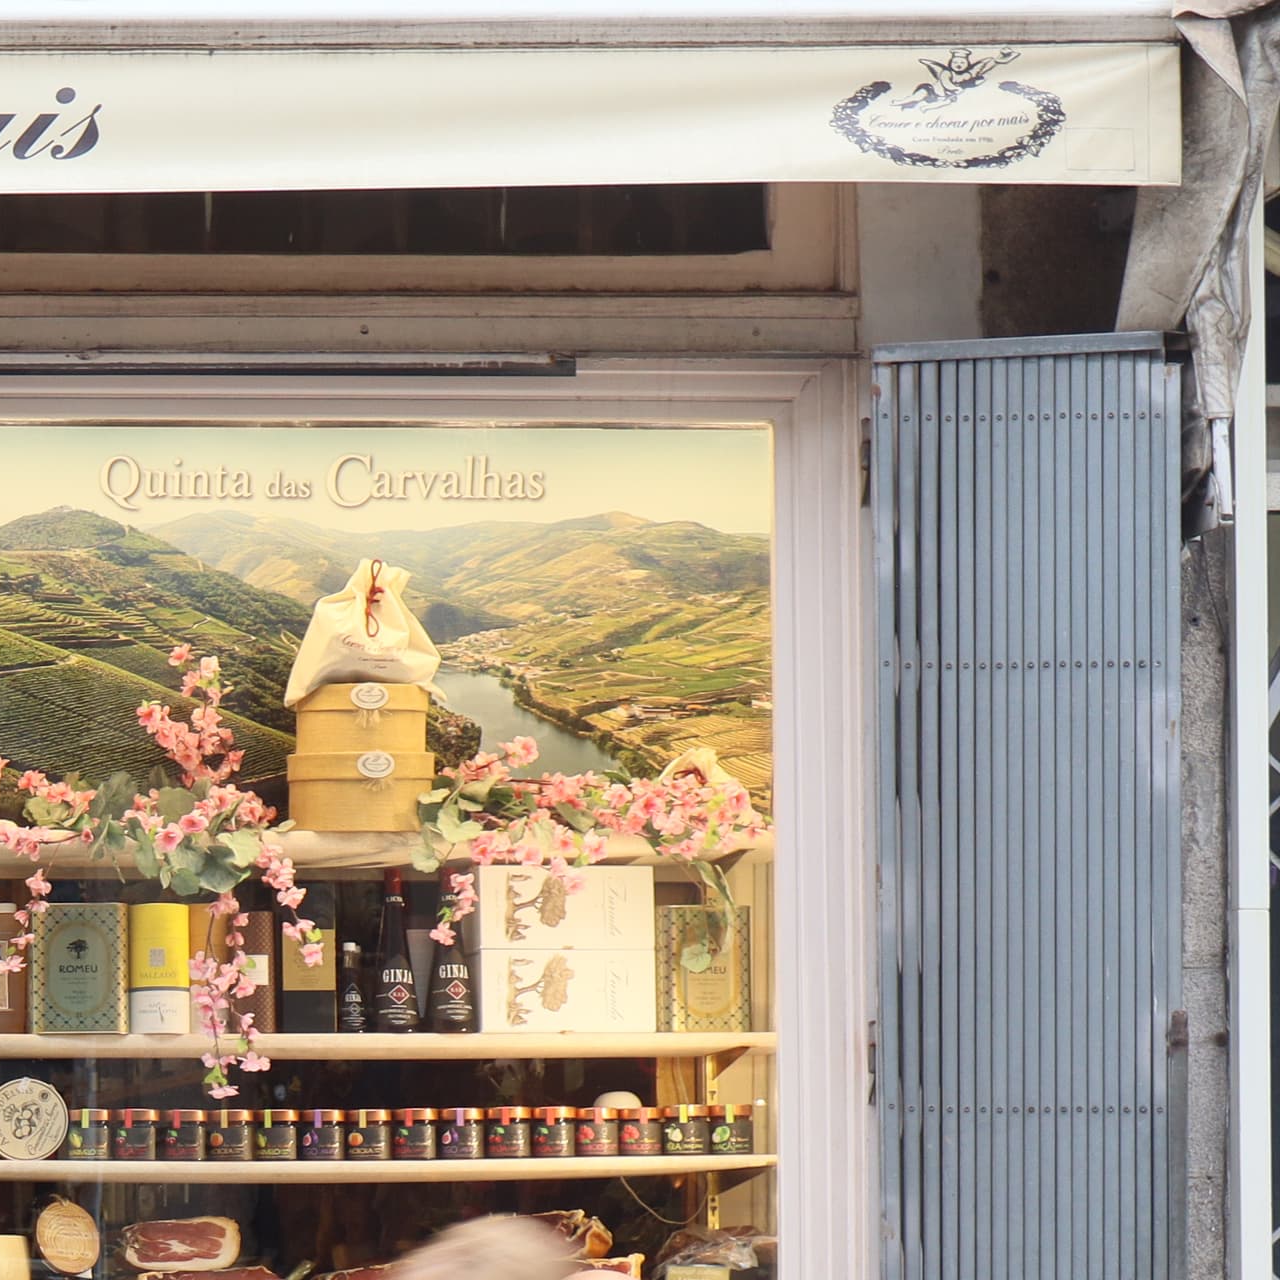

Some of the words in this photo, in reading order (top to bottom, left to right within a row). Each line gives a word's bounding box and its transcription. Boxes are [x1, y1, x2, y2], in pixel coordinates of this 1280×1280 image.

[925, 113, 969, 129] chorar
[969, 118, 995, 132] por
[997, 111, 1030, 126] mais
[98, 455, 254, 512] Quinta
[264, 471, 313, 500] das
[326, 454, 548, 508] Carvalhas
[58, 964, 99, 974] ROMEU
[382, 968, 414, 984] GINJA
[438, 963, 470, 979] GINJA
